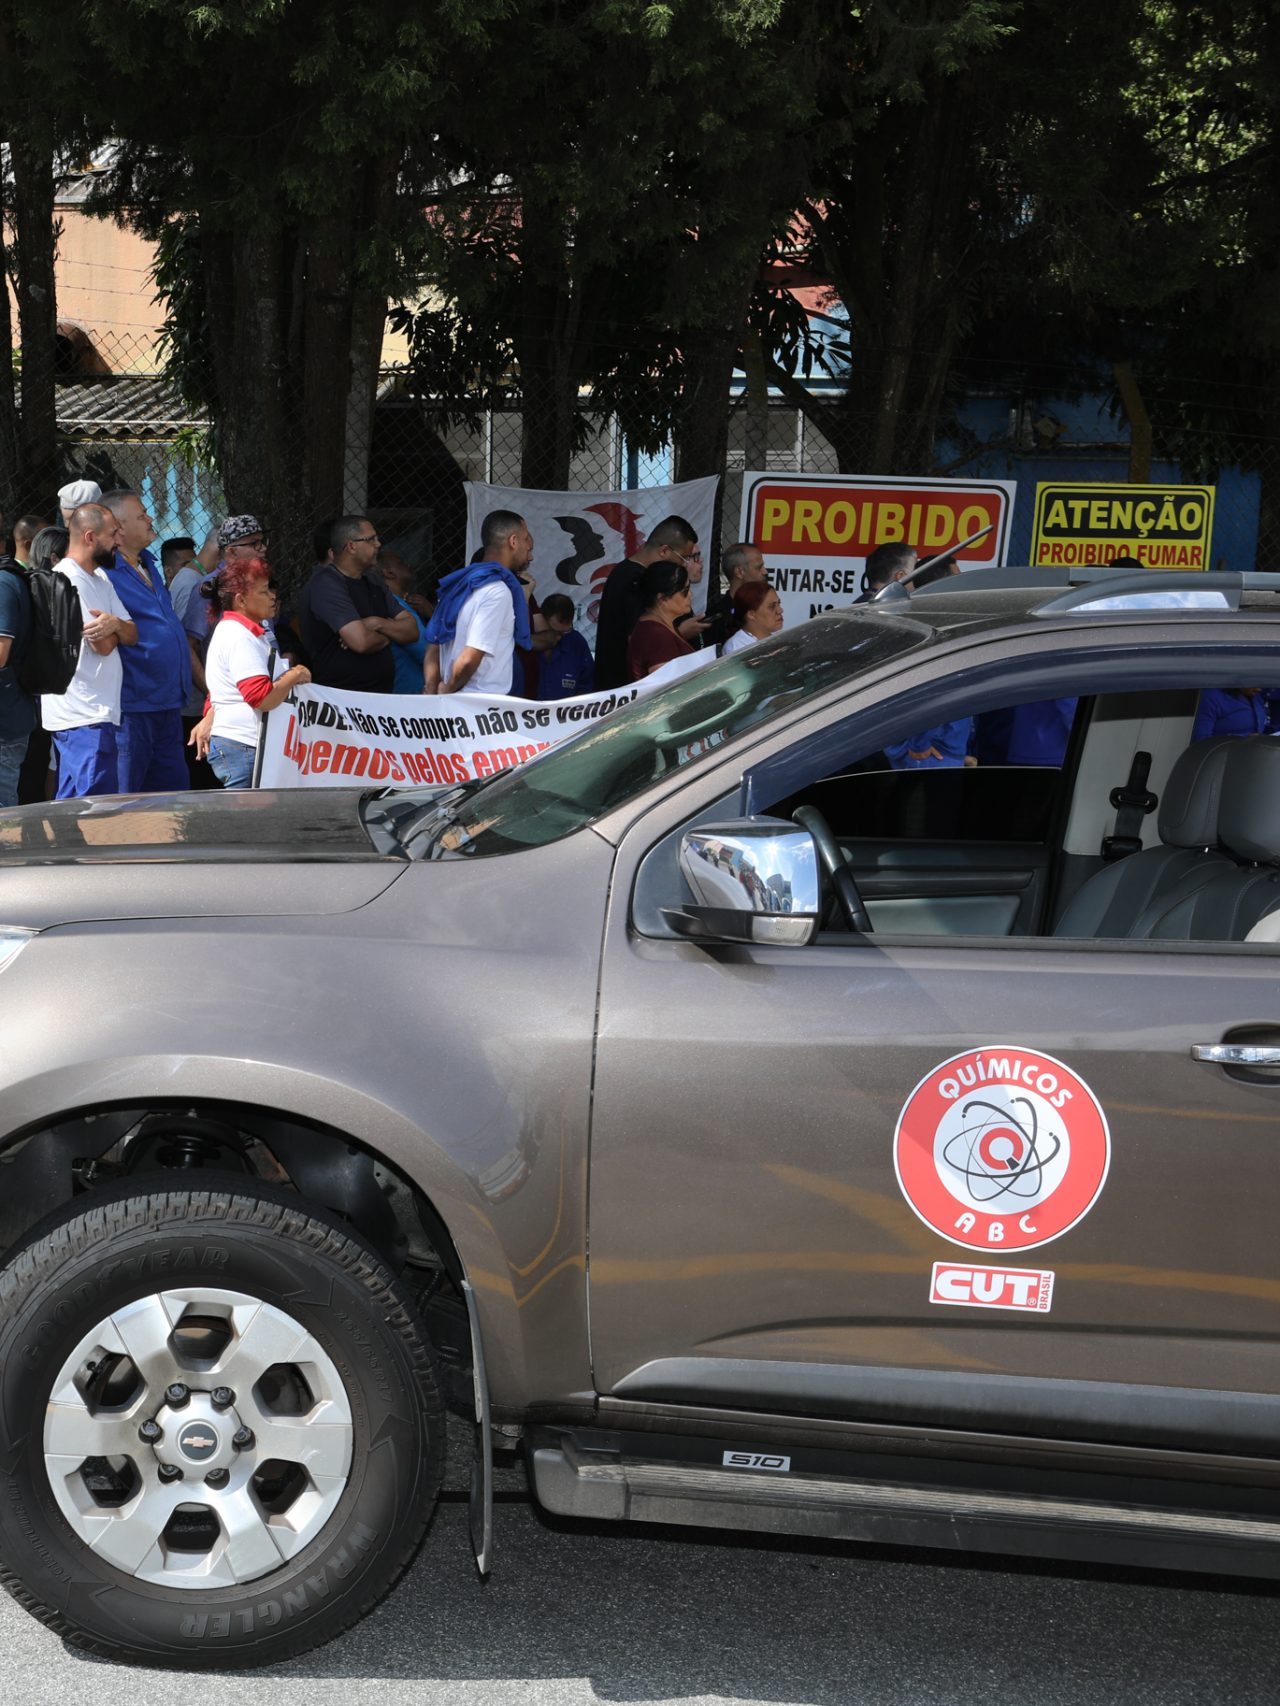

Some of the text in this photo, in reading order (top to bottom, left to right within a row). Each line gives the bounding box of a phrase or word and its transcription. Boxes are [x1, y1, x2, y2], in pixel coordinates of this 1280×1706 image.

[761, 498, 991, 548] PROIBIDO
[1044, 495, 1203, 538] ATENÇÃO
[1038, 543, 1202, 566] PROIBIDO FUMAR
[765, 568, 855, 594] ENTAR-SE
[346, 706, 380, 736] Não
[378, 715, 401, 738] se
[400, 715, 475, 742] compra,
[475, 707, 518, 736] não
[521, 706, 550, 730] se
[400, 747, 470, 785] pelos
[938, 1054, 1073, 1108] QUÍMICOS
[935, 1269, 1038, 1305] CUT
[1039, 1273, 1052, 1310] BRASIL
[728, 1454, 785, 1469] S10
[178, 1521, 380, 1639] WRANGLER
